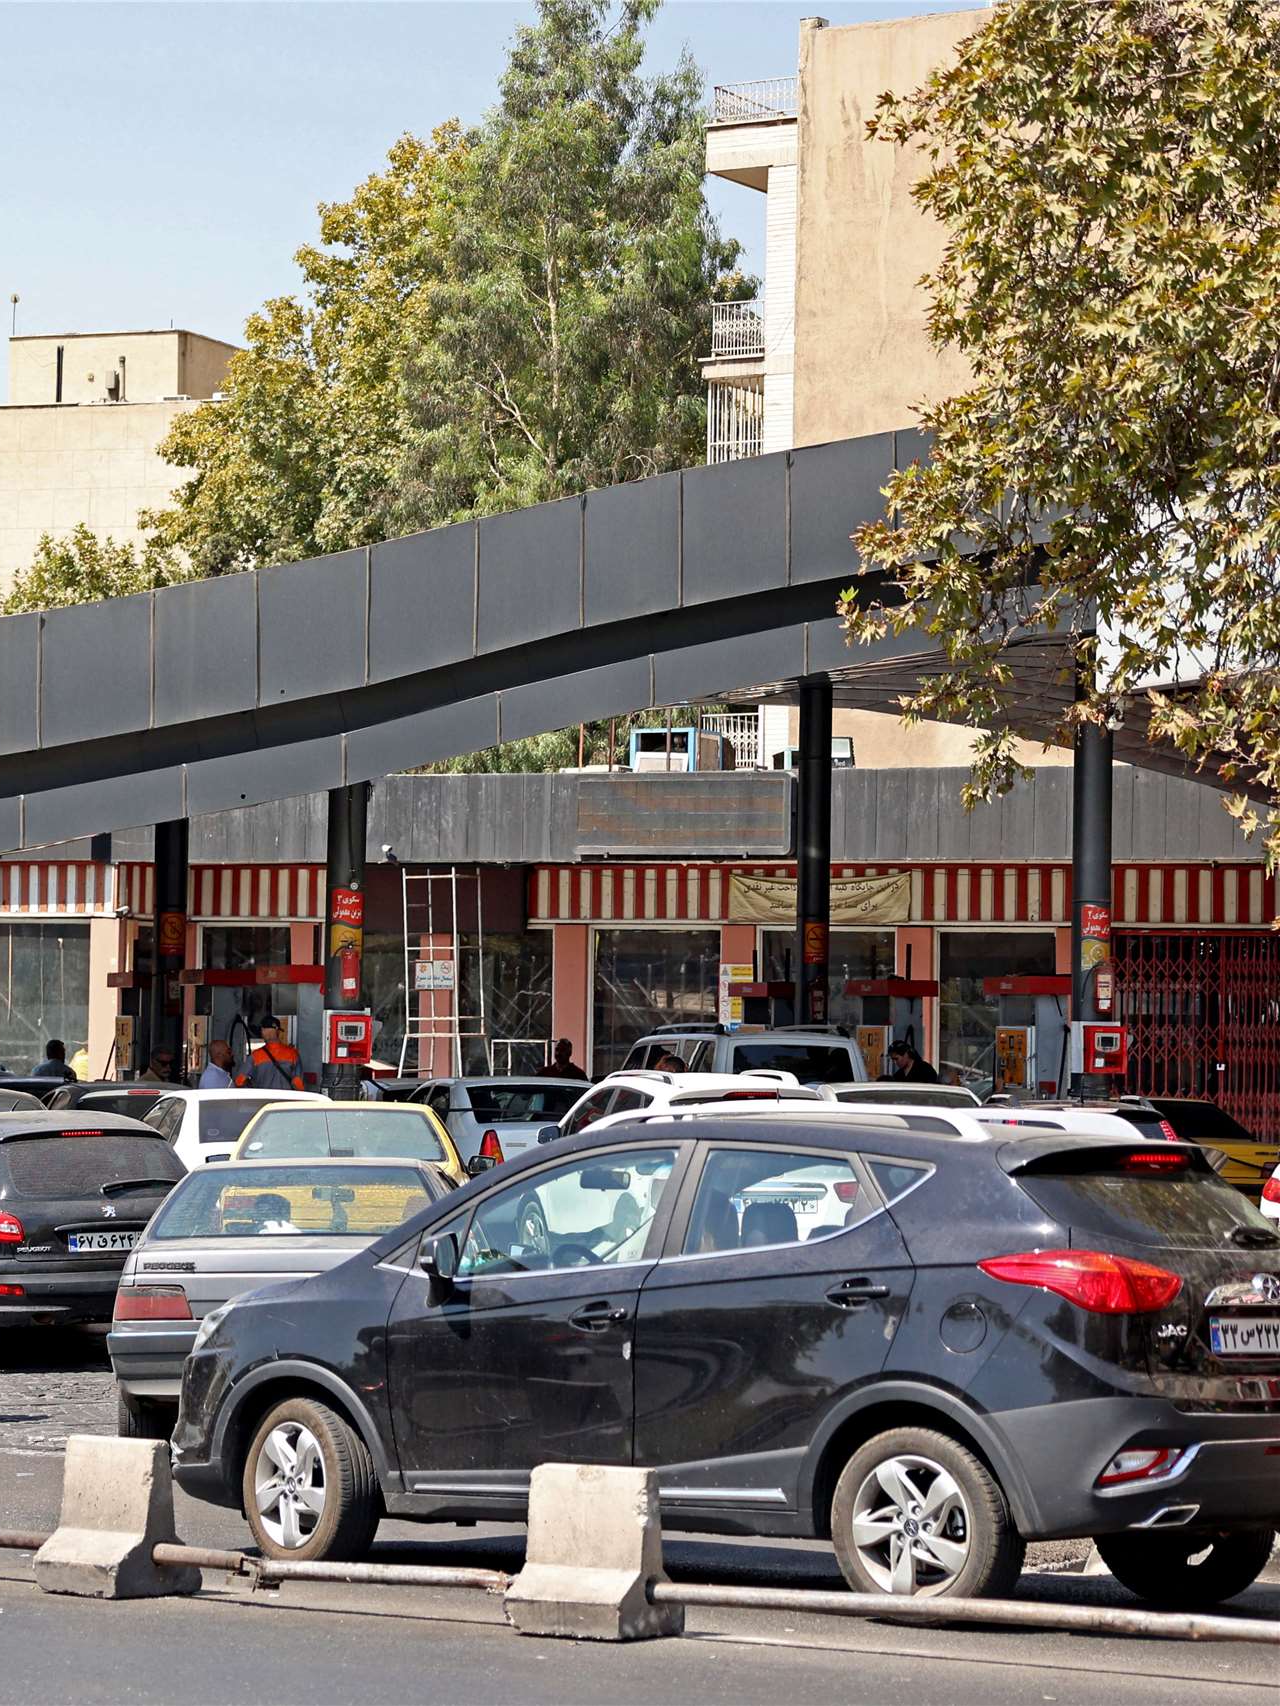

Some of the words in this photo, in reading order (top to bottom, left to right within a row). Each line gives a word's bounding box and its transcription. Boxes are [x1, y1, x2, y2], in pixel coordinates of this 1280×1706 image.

[342, 895, 360, 905] سکوی
[1092, 911, 1109, 920] سکوی
[16, 1245, 52, 1253] PEUGEOT
[143, 1262, 196, 1271] PEUGEOT
[1157, 1324, 1187, 1337] JAC
